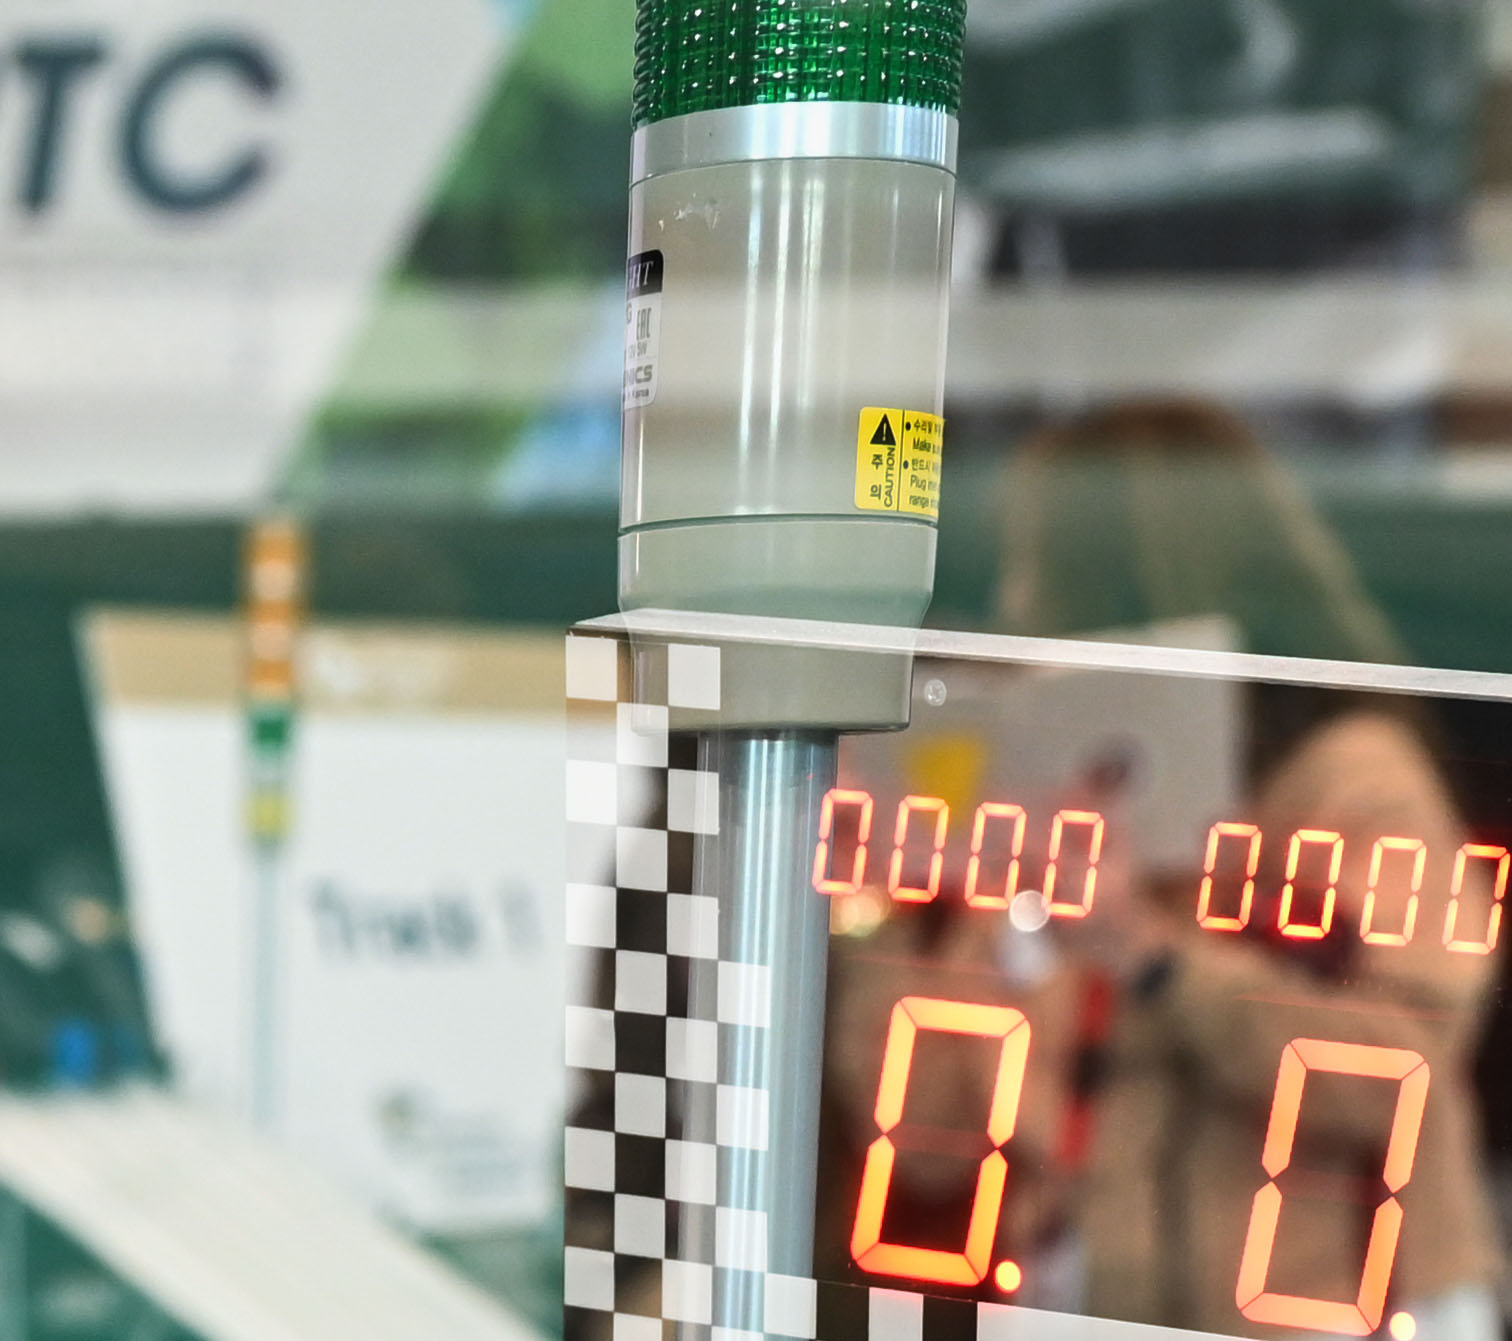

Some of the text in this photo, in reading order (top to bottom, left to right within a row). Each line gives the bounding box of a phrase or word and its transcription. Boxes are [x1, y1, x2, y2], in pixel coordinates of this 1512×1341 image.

[884, 447, 895, 507] CAUTION
[812, 788, 1105, 918] 0000
[1196, 822, 1511, 956] 0000
